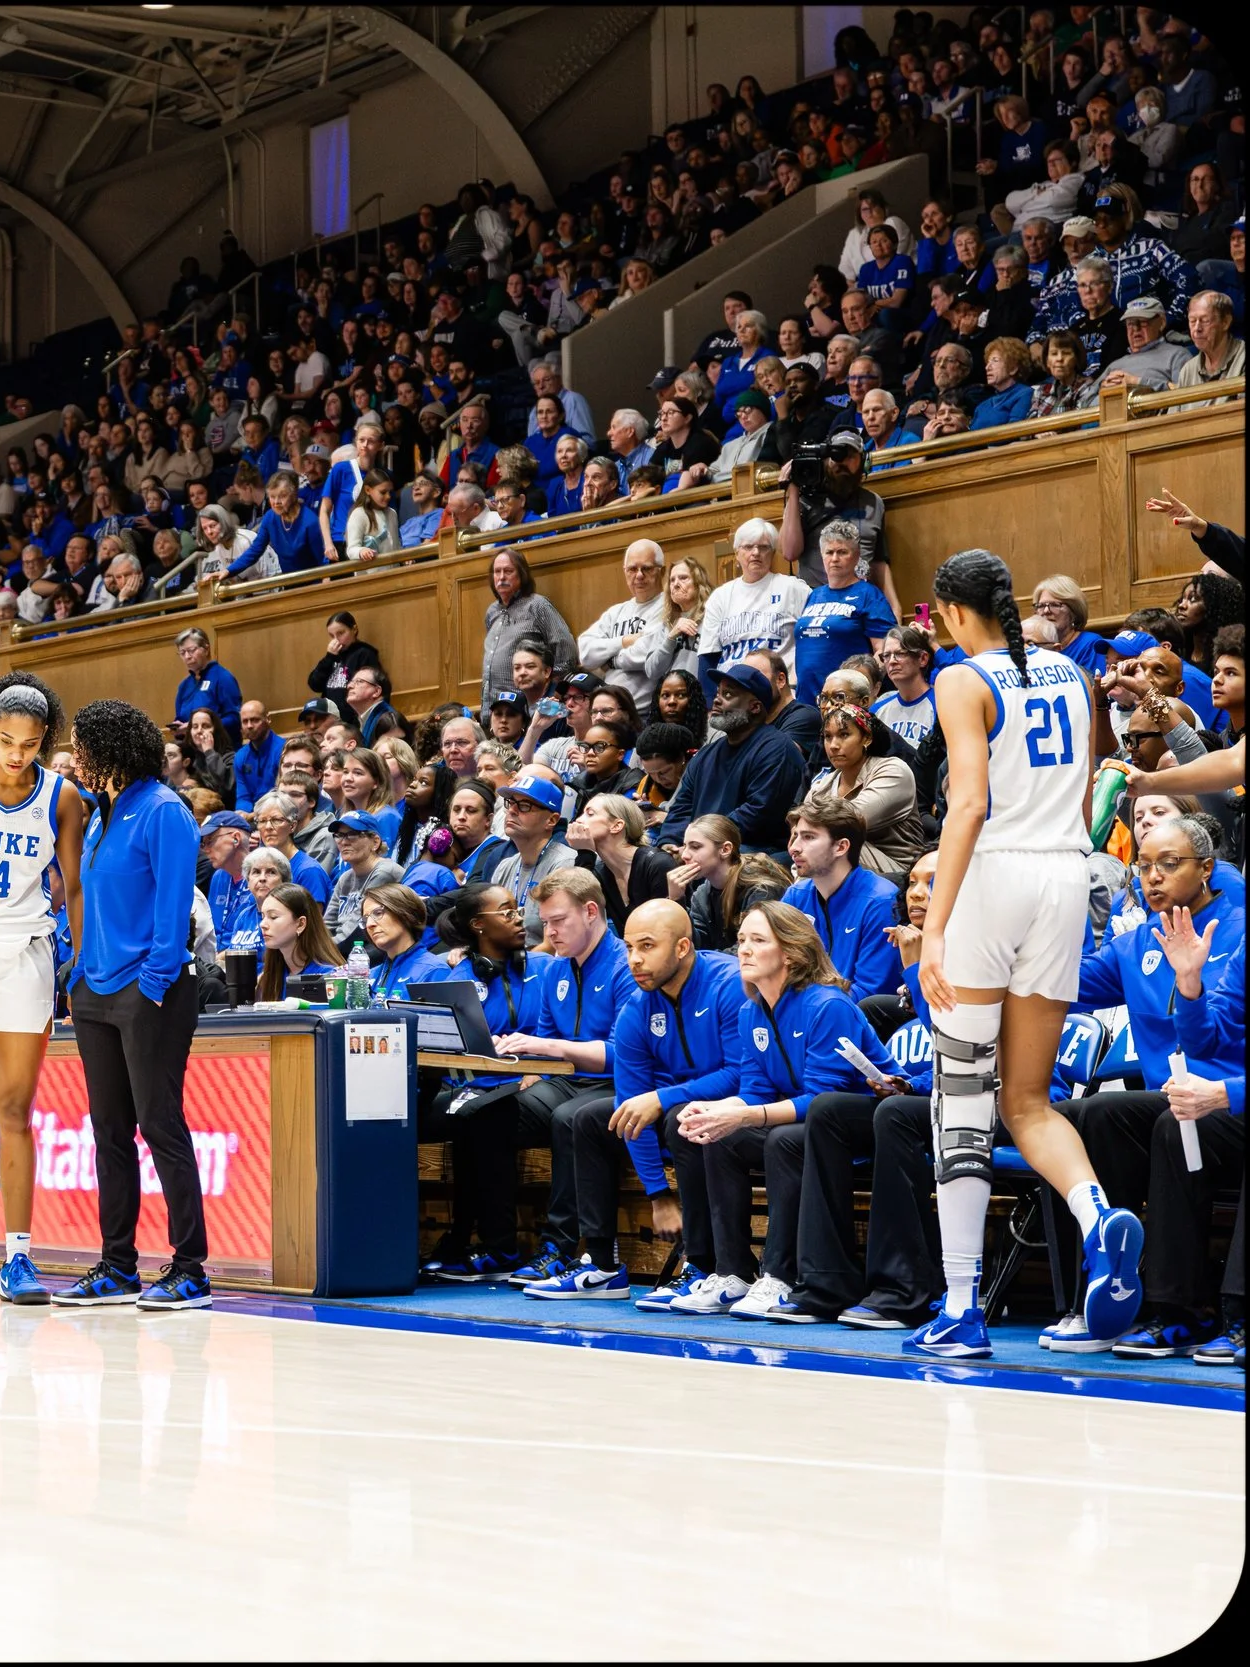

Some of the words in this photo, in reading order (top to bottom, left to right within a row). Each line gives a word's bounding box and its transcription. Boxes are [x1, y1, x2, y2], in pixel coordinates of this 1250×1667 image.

[708, 336, 743, 349] Duk
[993, 664, 1079, 690] ROERSON
[891, 721, 930, 744] UKE
[1025, 695, 1074, 768] 21
